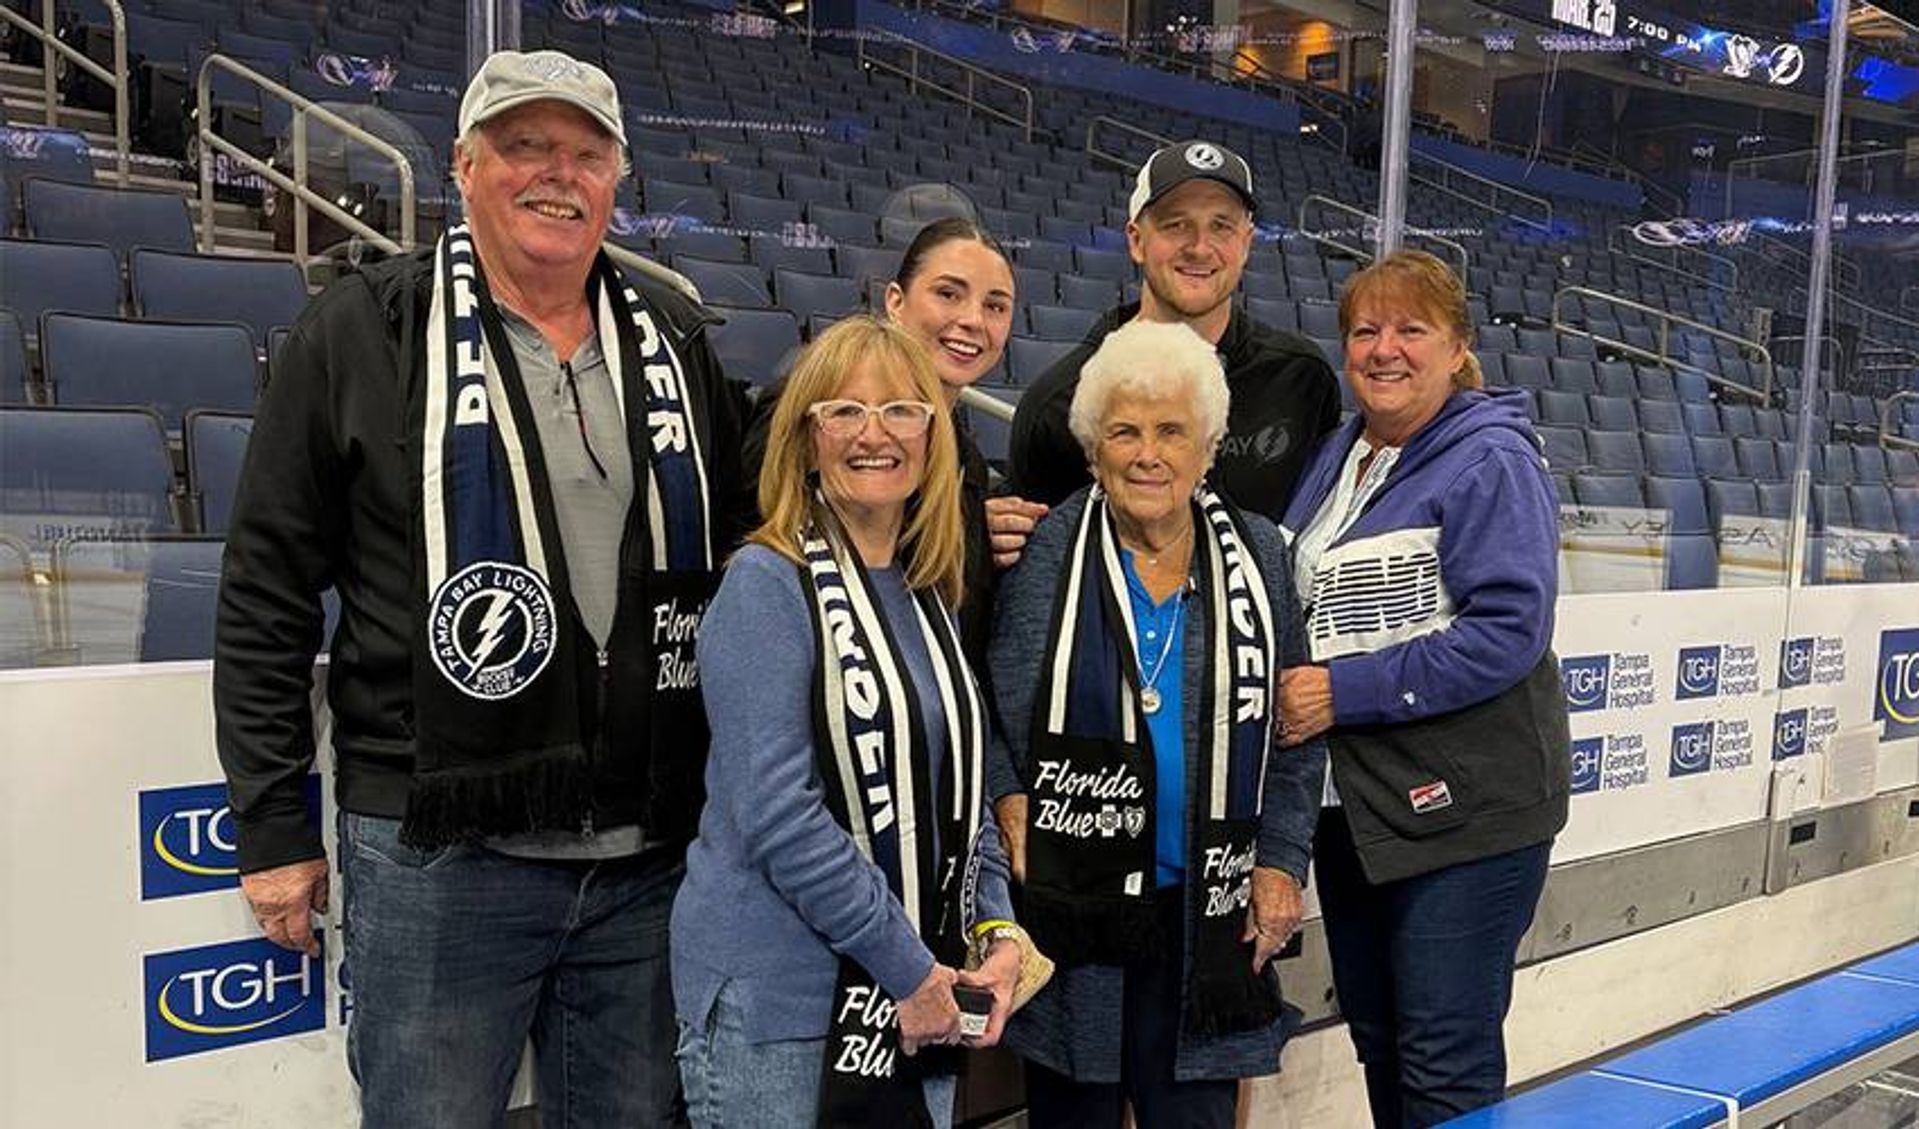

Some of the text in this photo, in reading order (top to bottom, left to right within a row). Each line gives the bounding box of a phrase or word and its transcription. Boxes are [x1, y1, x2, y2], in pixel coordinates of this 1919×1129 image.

[1627, 16, 1668, 40] 7:00
[436, 571, 549, 672] TAMPA BAY LIGHTNING
[1613, 653, 1649, 669] Tampa
[1723, 645, 1755, 661] Tampa
[1611, 669, 1654, 689] General
[1686, 656, 1717, 680] TGH
[1722, 661, 1759, 678] General
[1567, 667, 1606, 693] TGH
[1720, 676, 1761, 695] Hospital
[1609, 688, 1655, 710] Hospital
[1718, 719, 1749, 735] Tampa
[1607, 734, 1643, 751] Tampa
[1680, 734, 1711, 758] TGH
[1715, 734, 1752, 751] General
[1605, 750, 1647, 771] General
[1034, 759, 1144, 799] Florida
[1603, 768, 1649, 790] Hospital
[1034, 799, 1095, 839] Blue
[179, 954, 310, 1016] TGH
